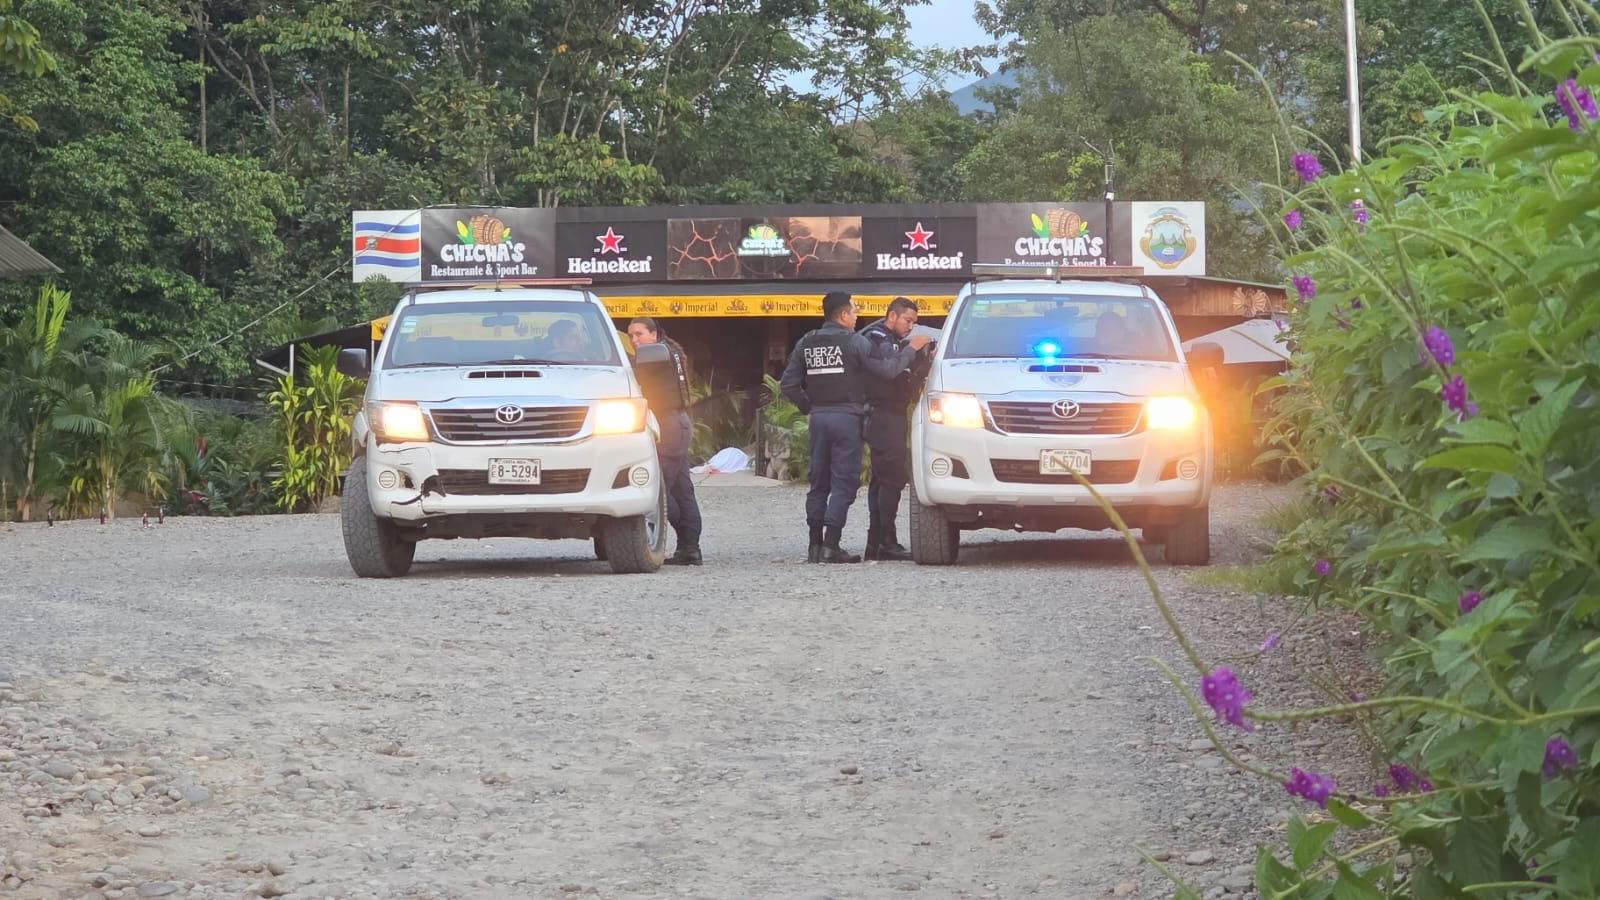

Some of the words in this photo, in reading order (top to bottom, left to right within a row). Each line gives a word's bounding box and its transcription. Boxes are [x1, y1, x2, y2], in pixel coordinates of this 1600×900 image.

[440, 240, 526, 262] CHICHA'S
[1015, 234, 1104, 256] CHICHA'S
[567, 257, 651, 274] Heineken
[876, 253, 962, 270] Heineken
[431, 264, 483, 277] Restaurante
[485, 263, 494, 276] &
[521, 263, 538, 275] Bar
[685, 302, 718, 313] Imperial
[804, 345, 843, 358] FUERZA
[498, 464, 538, 479] 8-5294
